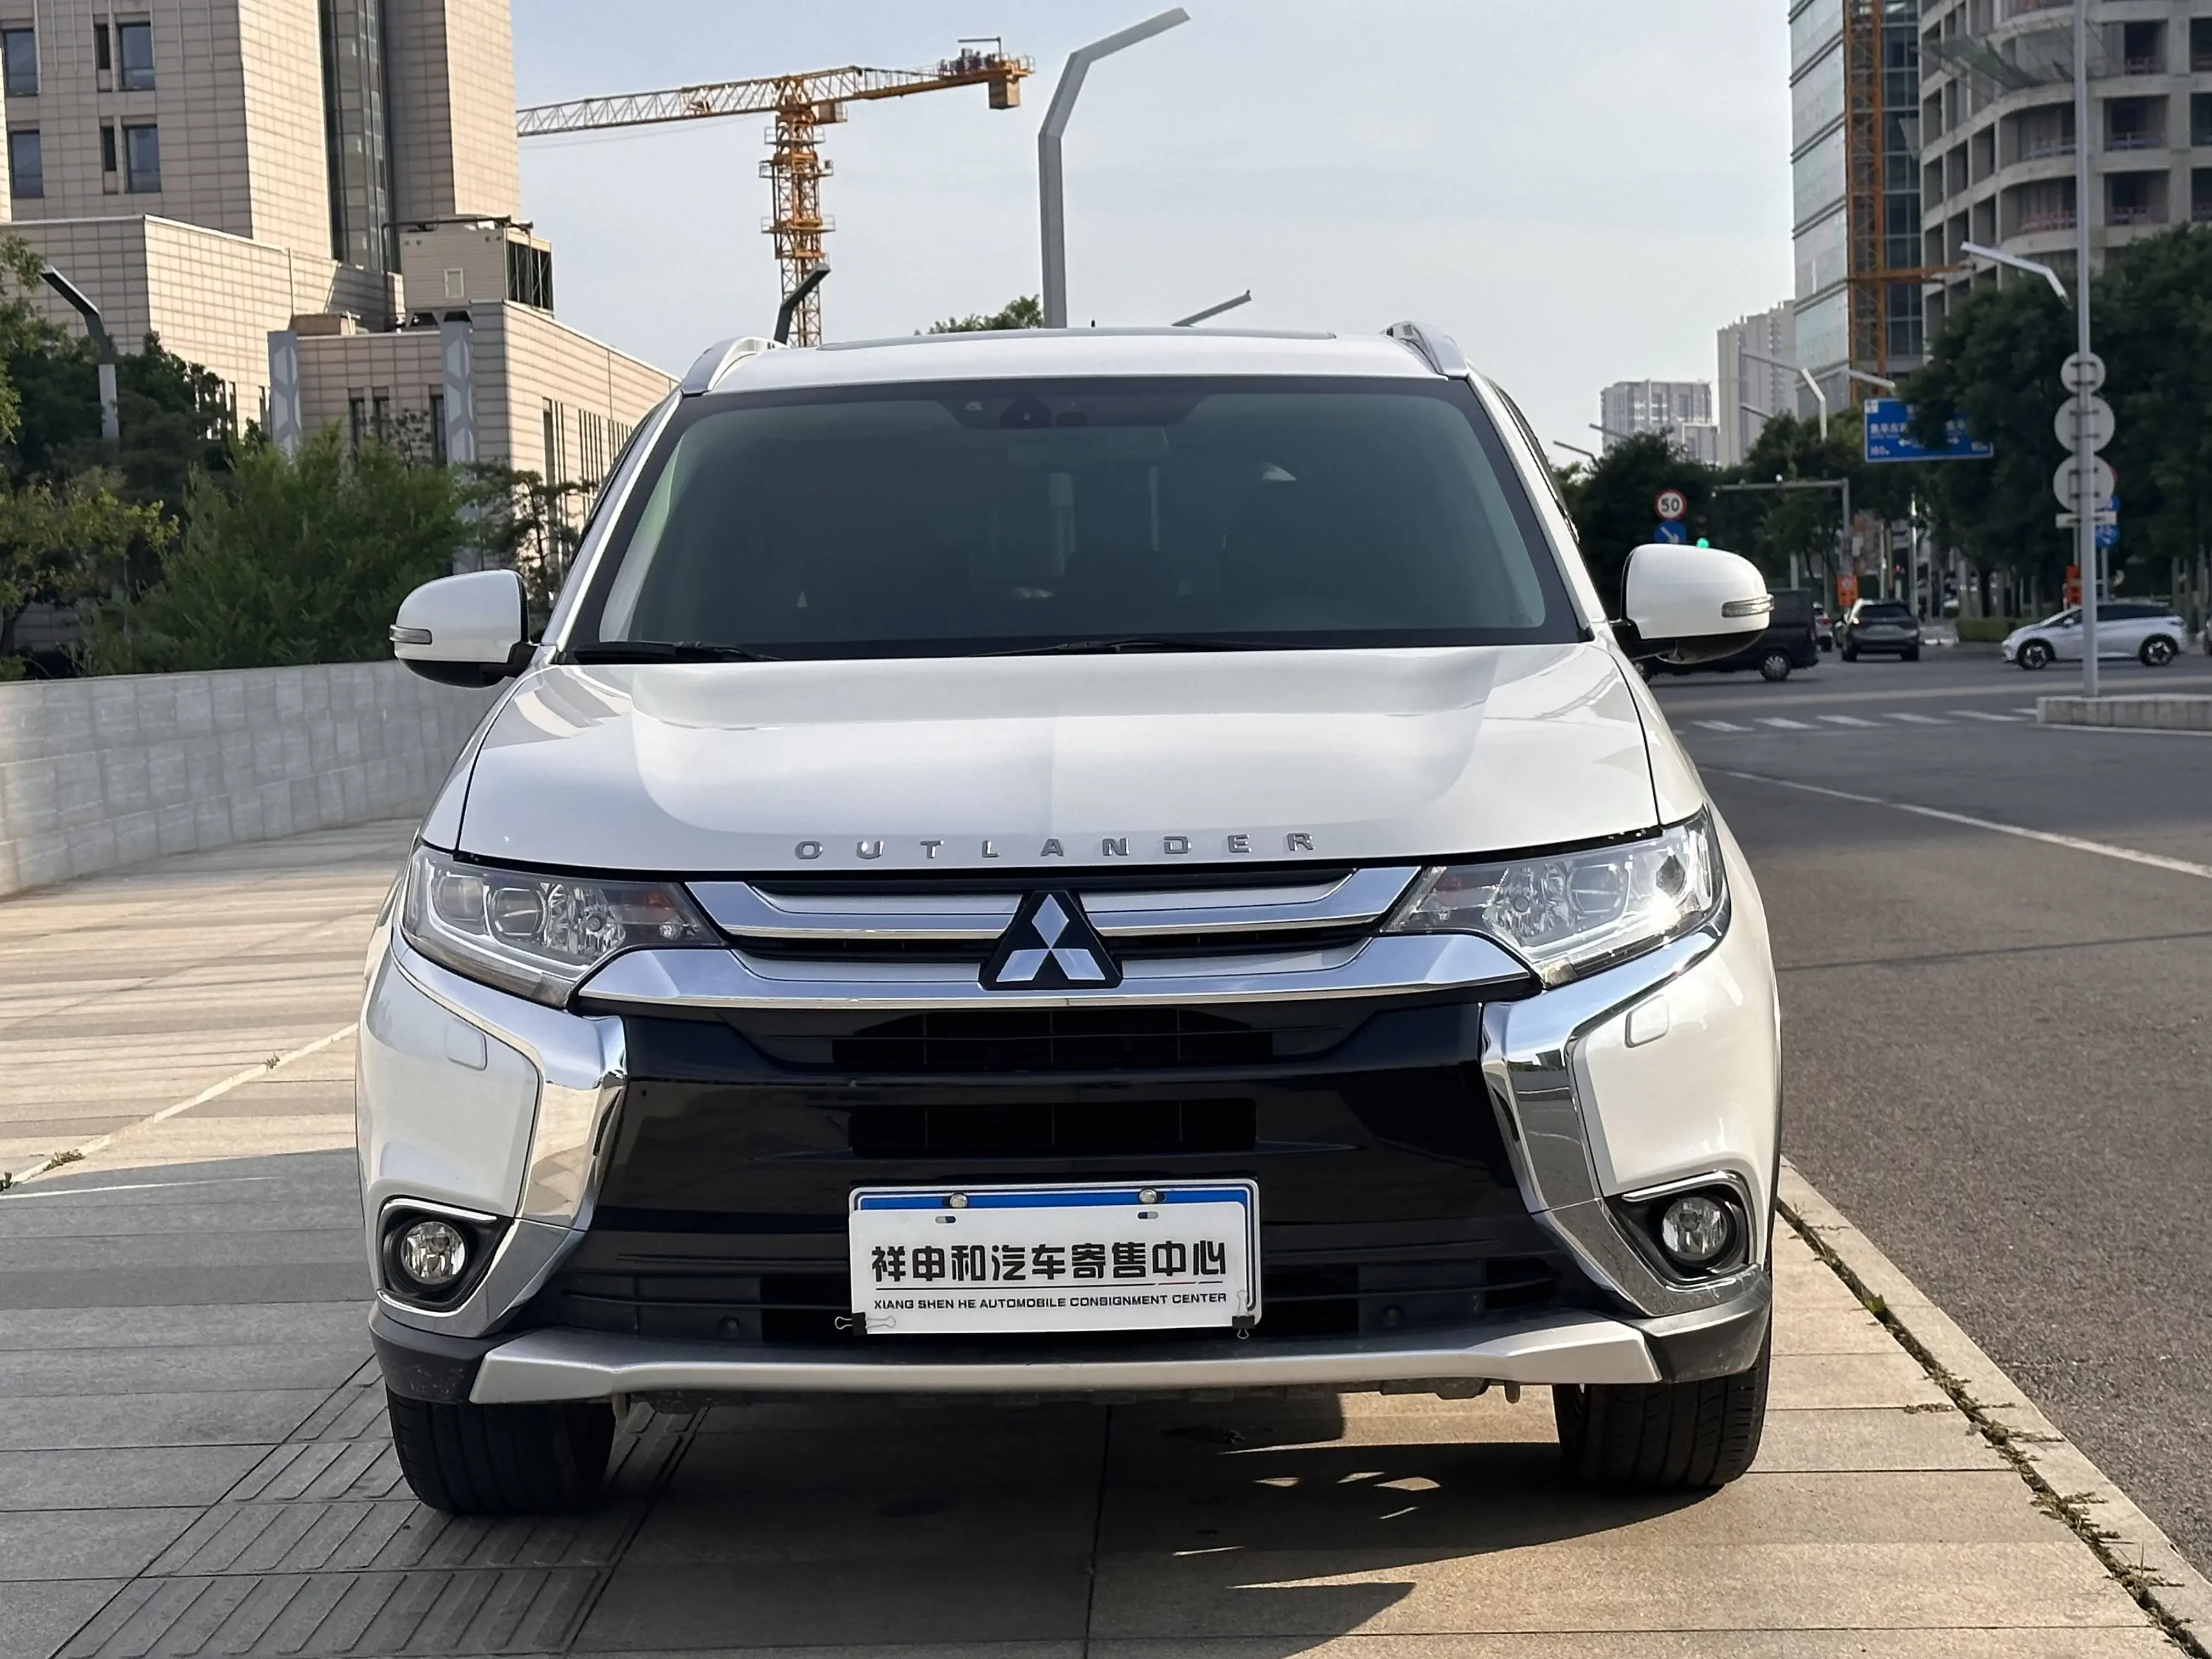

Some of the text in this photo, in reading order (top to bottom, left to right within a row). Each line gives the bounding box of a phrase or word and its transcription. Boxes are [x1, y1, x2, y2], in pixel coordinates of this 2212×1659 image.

[1661, 497, 1680, 512] 50
[794, 832, 1316, 860] OUTLANDER
[871, 1239, 1227, 1282] 祥申和汽车寄售中心
[874, 1293, 1227, 1310] XIANG SHEN HE AUTOMOBILE CONSIGNMENT CENTER
